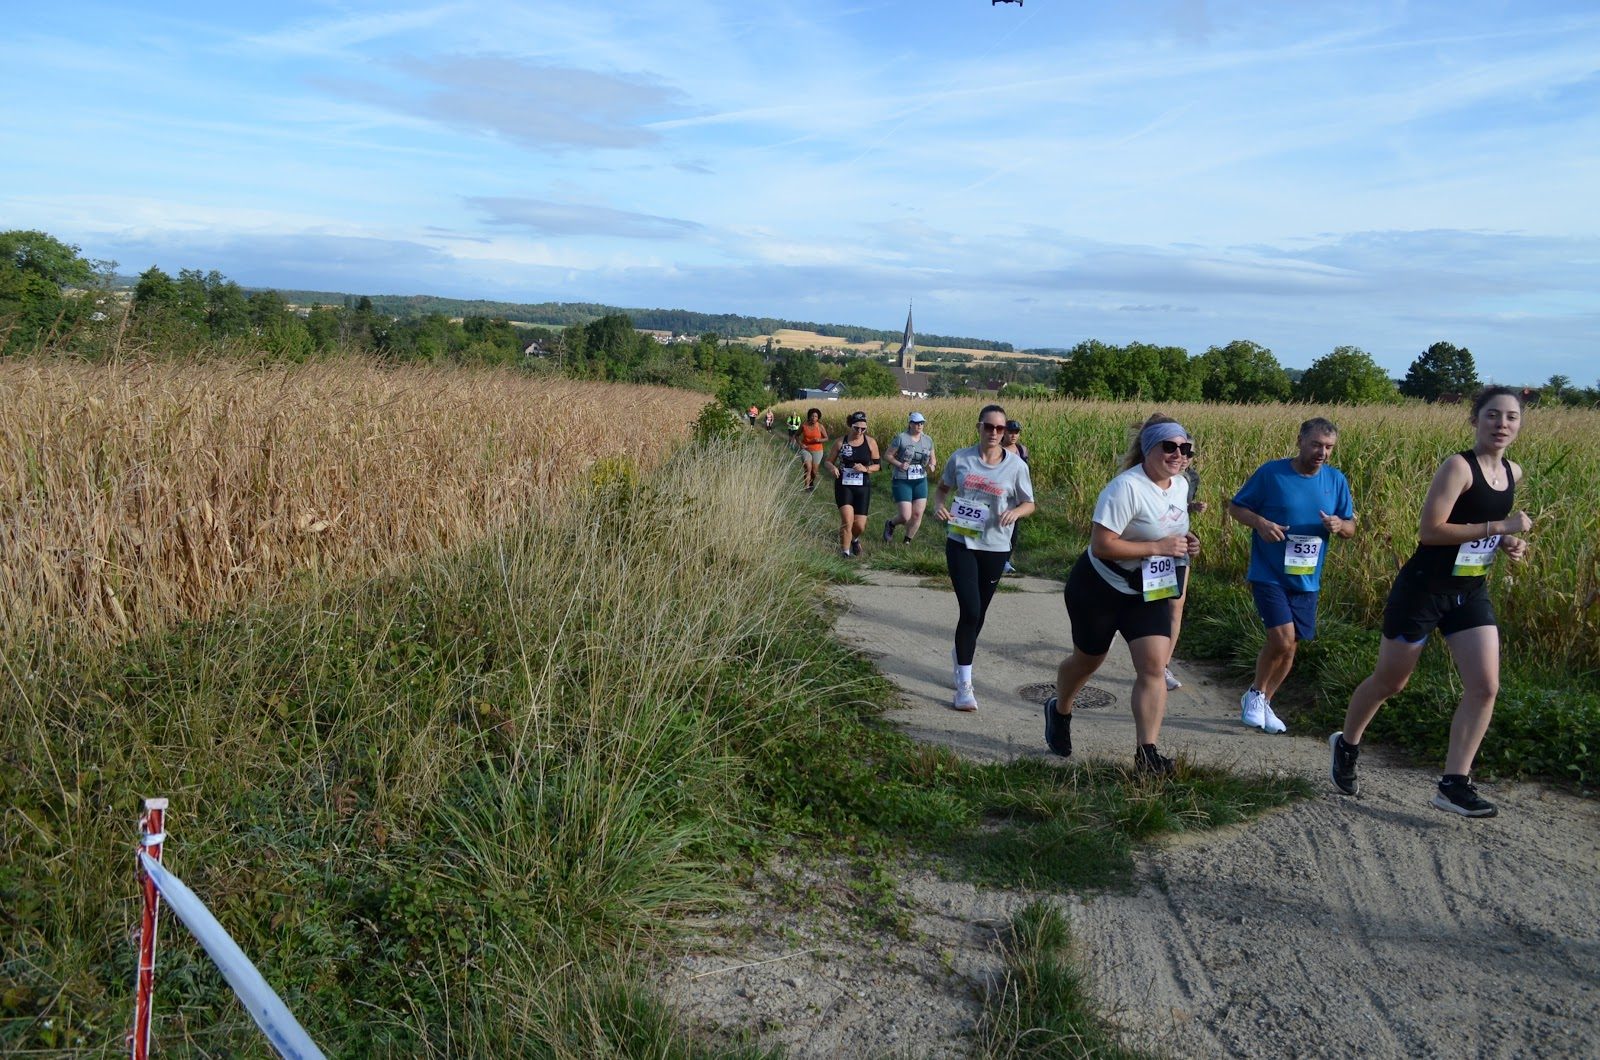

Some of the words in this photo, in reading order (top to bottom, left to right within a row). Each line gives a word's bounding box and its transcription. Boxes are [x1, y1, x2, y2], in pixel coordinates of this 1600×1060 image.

[957, 505, 982, 519] 525
[1293, 543, 1317, 554] 533
[1470, 535, 1497, 549] 518
[1150, 558, 1171, 574] 509
